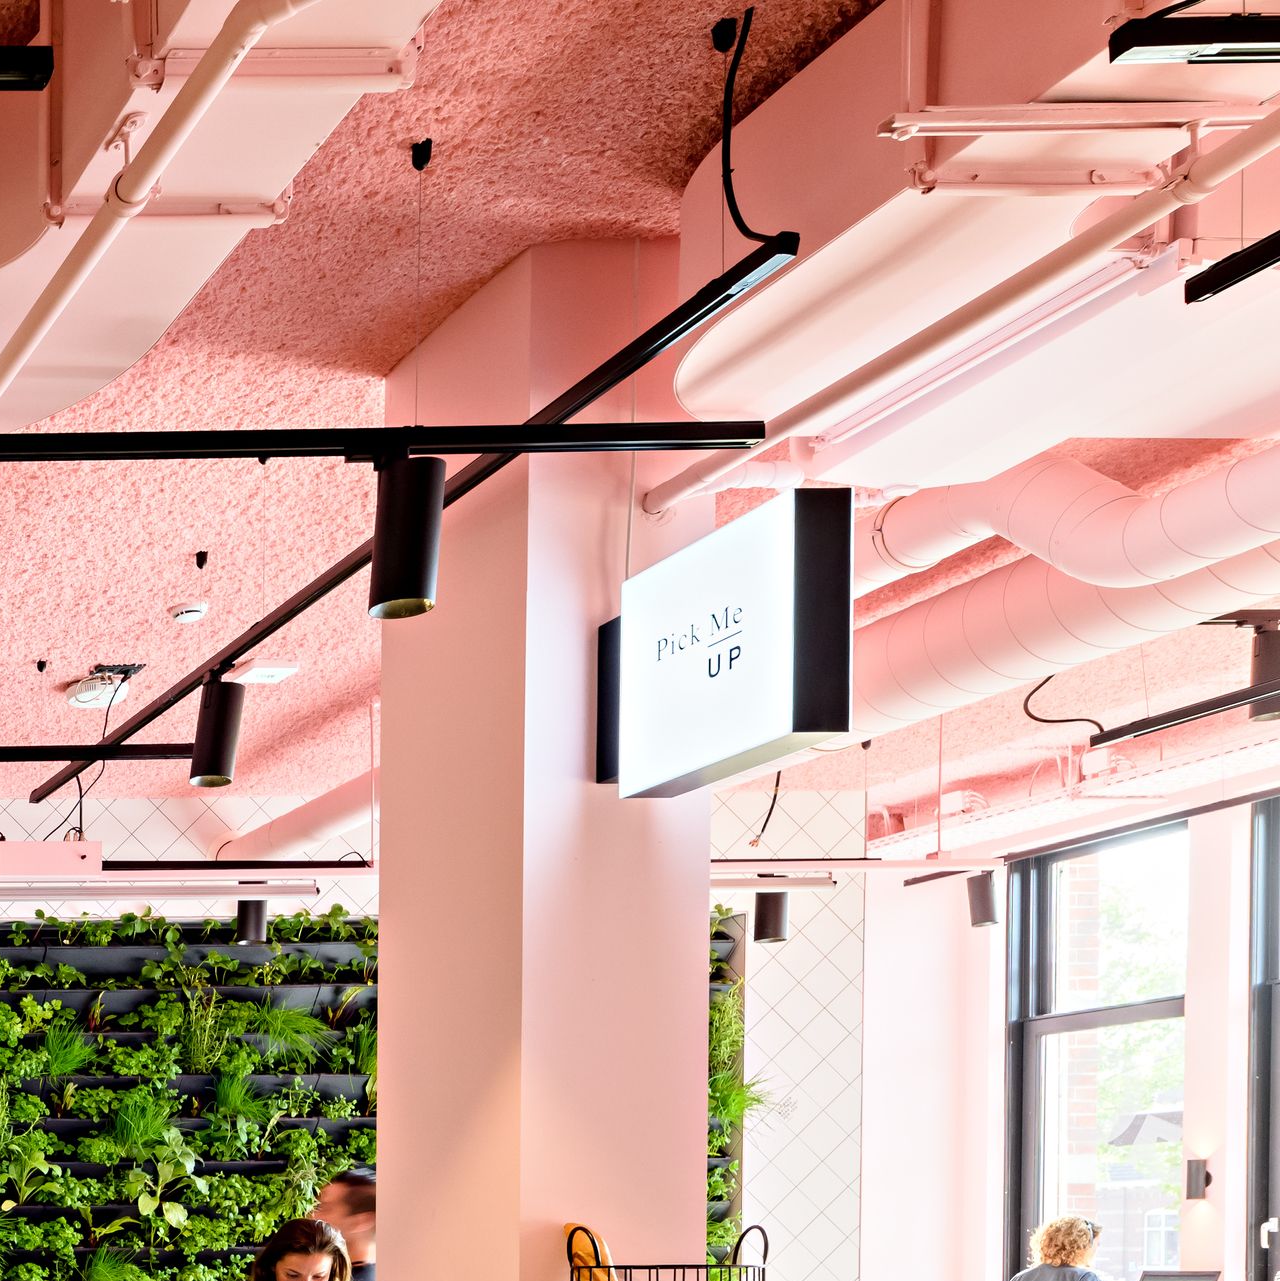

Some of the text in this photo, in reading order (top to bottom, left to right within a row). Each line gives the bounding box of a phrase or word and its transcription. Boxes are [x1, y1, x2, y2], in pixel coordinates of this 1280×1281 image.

[656, 605, 743, 662] Pick Me
[707, 645, 742, 678] UP
